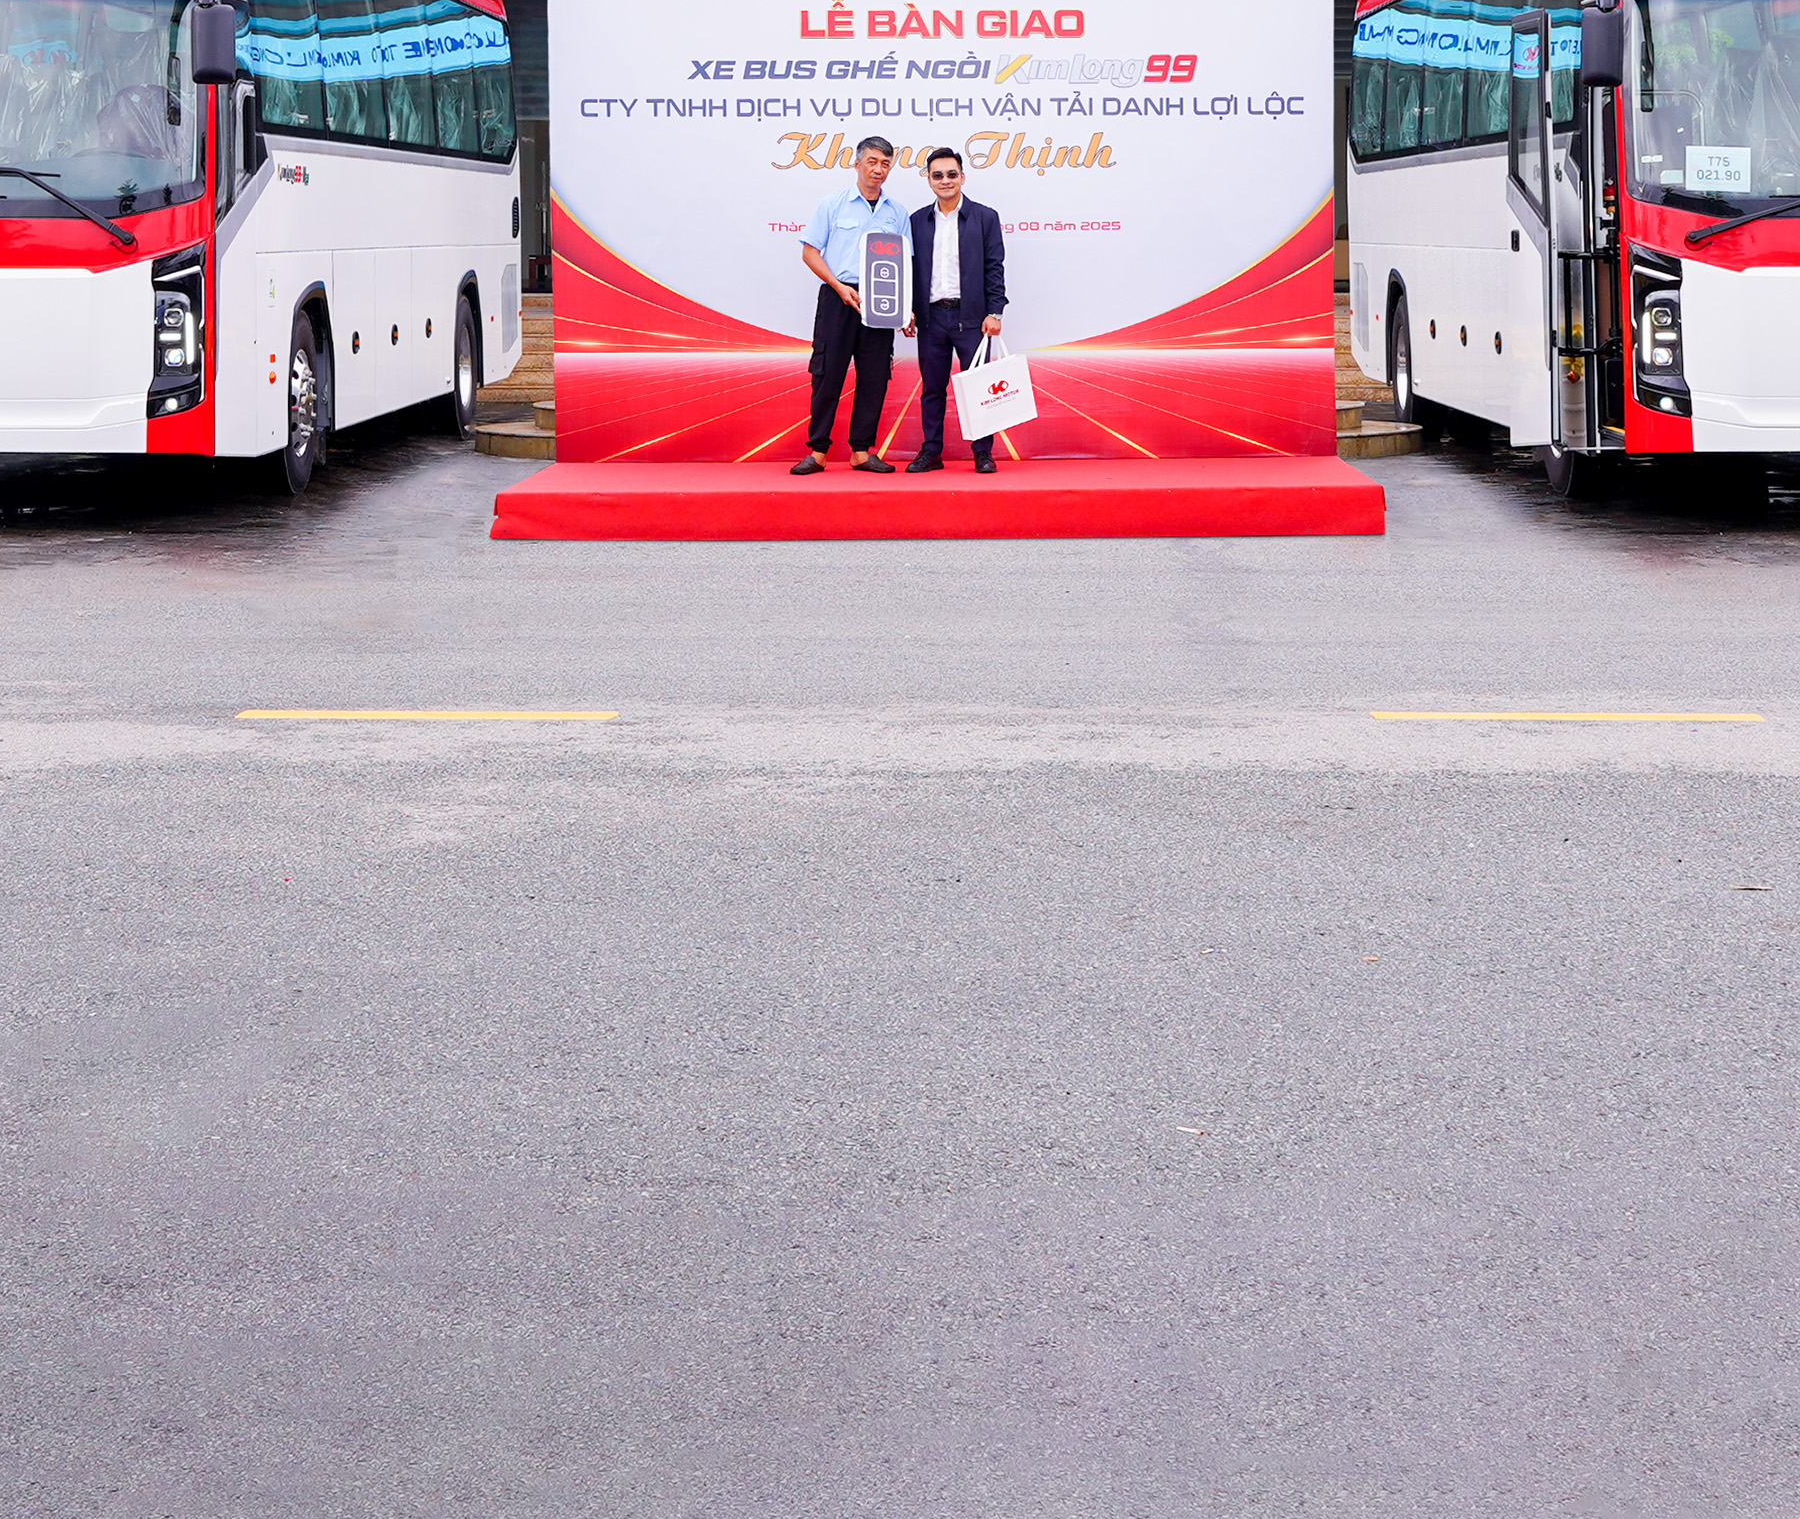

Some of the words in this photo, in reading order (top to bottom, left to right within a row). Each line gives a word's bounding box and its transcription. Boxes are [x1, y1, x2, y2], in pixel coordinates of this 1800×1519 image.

[866, 2, 964, 39] BÀN
[976, 9, 1085, 39] GIAO
[687, 60, 736, 80] XE
[743, 60, 817, 80] BUS
[825, 51, 899, 80] GHẾ
[905, 51, 991, 80] NGỒI
[580, 98, 638, 117] CTY
[646, 98, 727, 117] TNHH
[736, 98, 801, 122] DỊCH
[810, 98, 852, 122] VỤ
[861, 98, 901, 117] DU
[911, 97, 973, 122] LỊCH
[982, 93, 1041, 121] VẬN
[1050, 91, 1093, 117] TẢI
[1102, 97, 1184, 117] DANH
[1193, 94, 1238, 120] LỢI
[1248, 91, 1305, 120] LỘC
[965, 131, 1117, 176] Thịnh
[1696, 169, 1741, 181] 021.90
[1018, 221, 1040, 231] 08
[1043, 220, 1076, 231] năm
[1080, 221, 1121, 231] 2025
